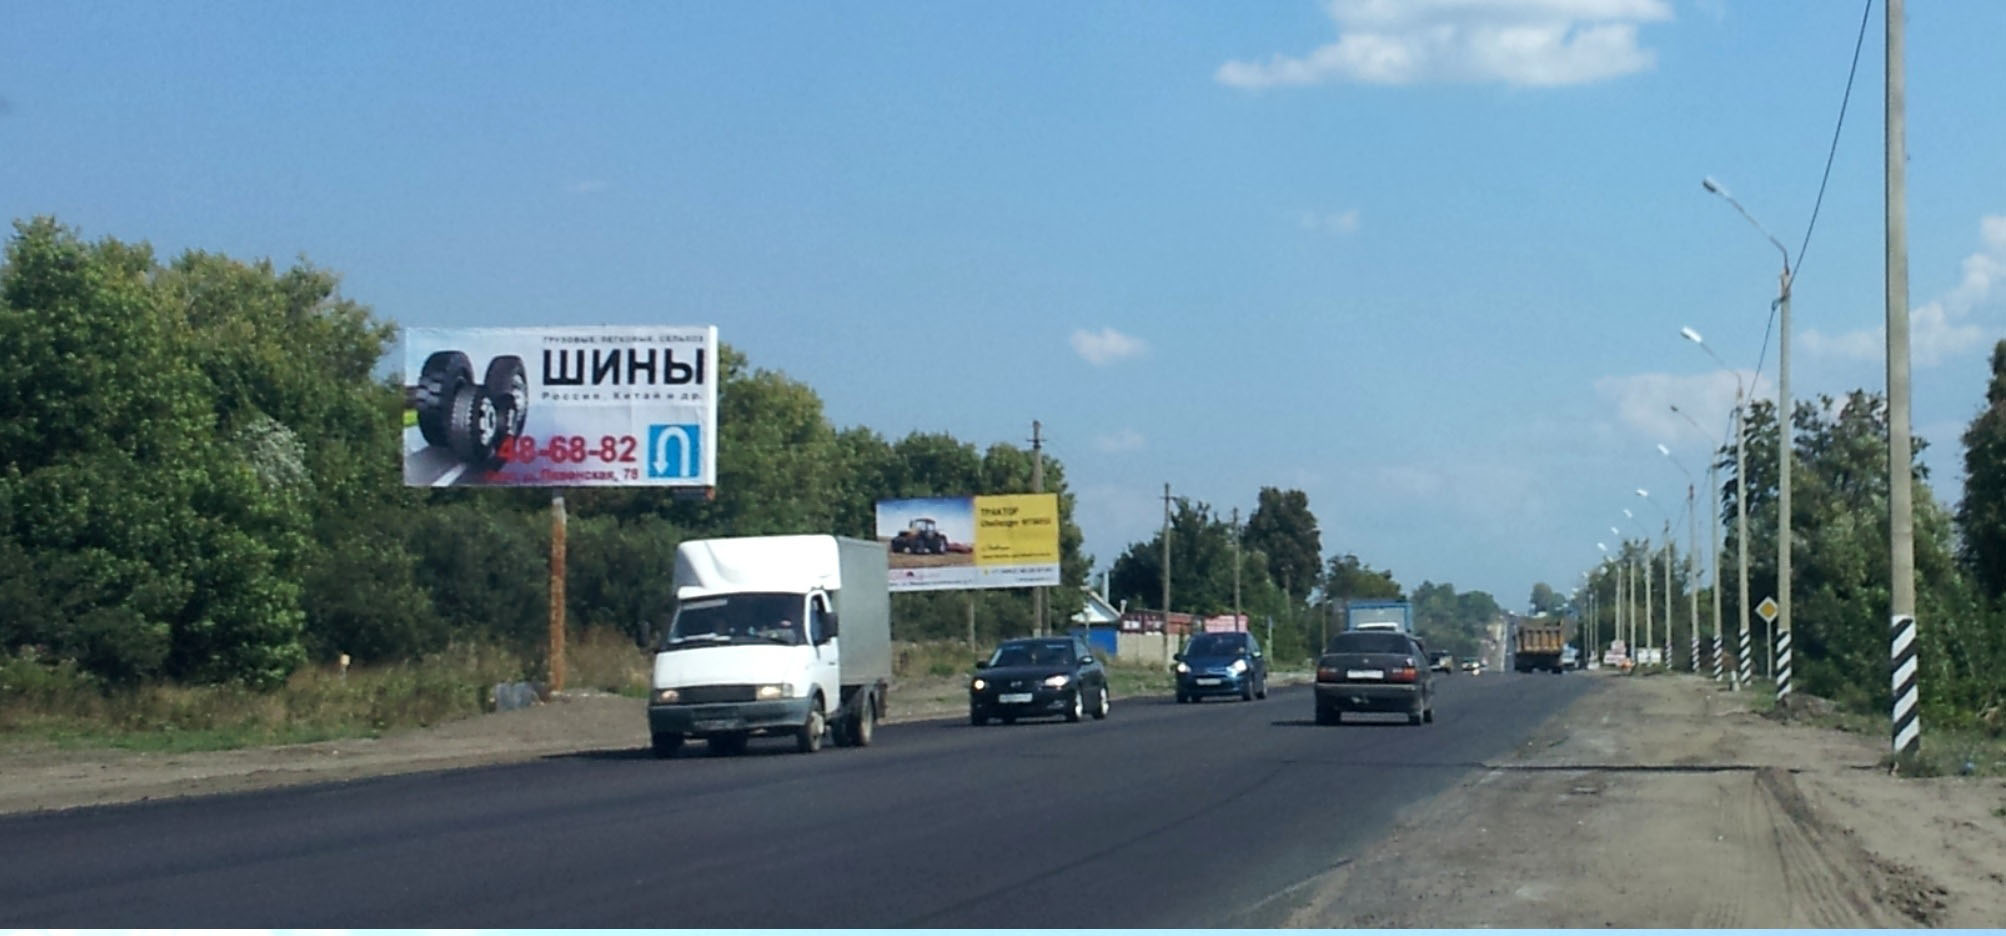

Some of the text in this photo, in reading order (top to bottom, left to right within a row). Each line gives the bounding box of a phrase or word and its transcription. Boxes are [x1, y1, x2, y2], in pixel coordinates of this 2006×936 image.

[543, 348, 704, 386] ШИНЫ
[497, 435, 637, 464] 48-68-82
[623, 468, 639, 480] 78
